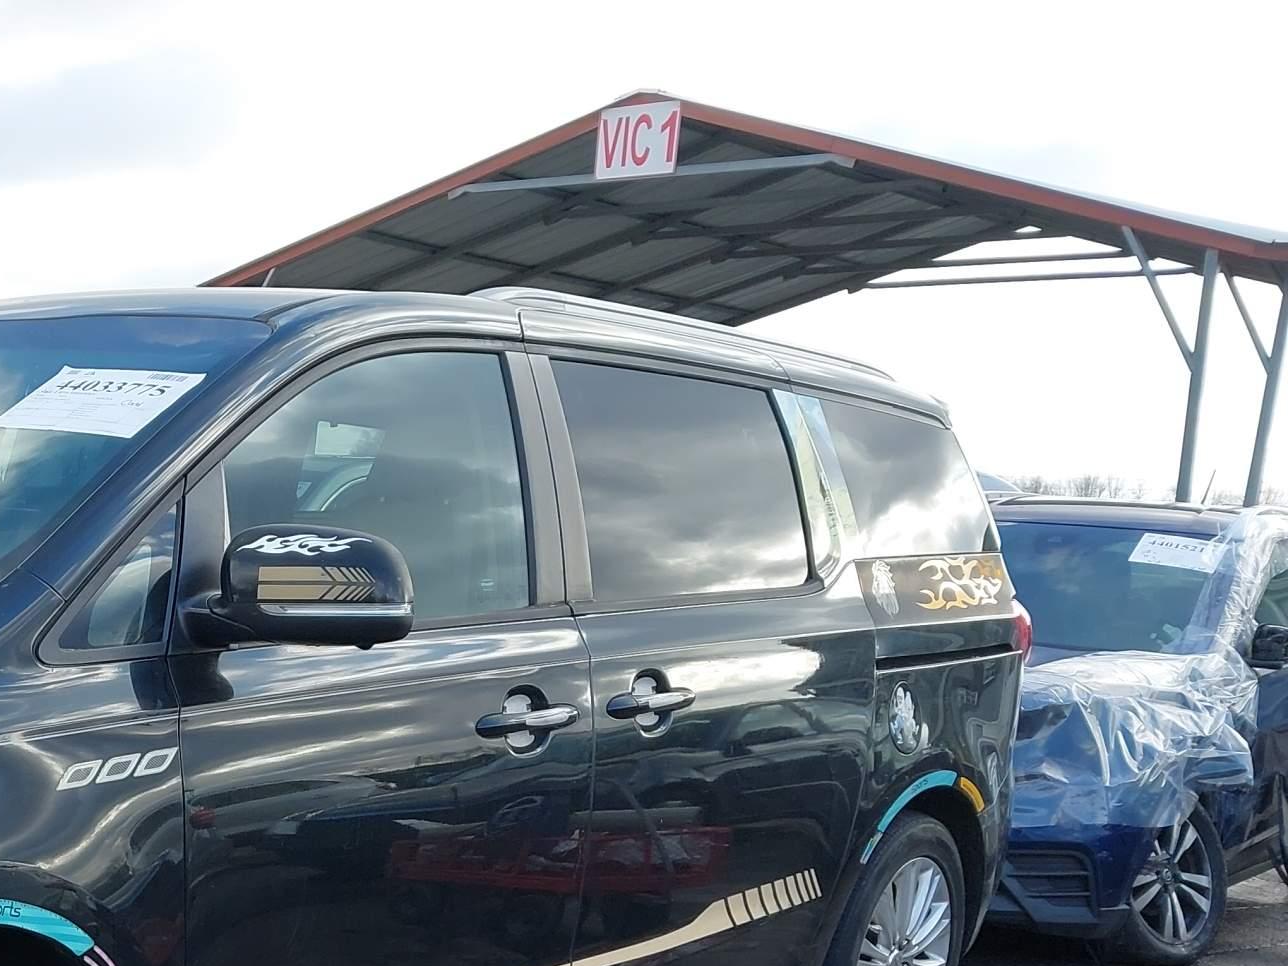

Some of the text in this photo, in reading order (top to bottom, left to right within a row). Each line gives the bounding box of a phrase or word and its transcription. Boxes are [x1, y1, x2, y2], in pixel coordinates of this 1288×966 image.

[601, 110, 679, 169] VIC 1
[56, 379, 173, 397] 44033775
